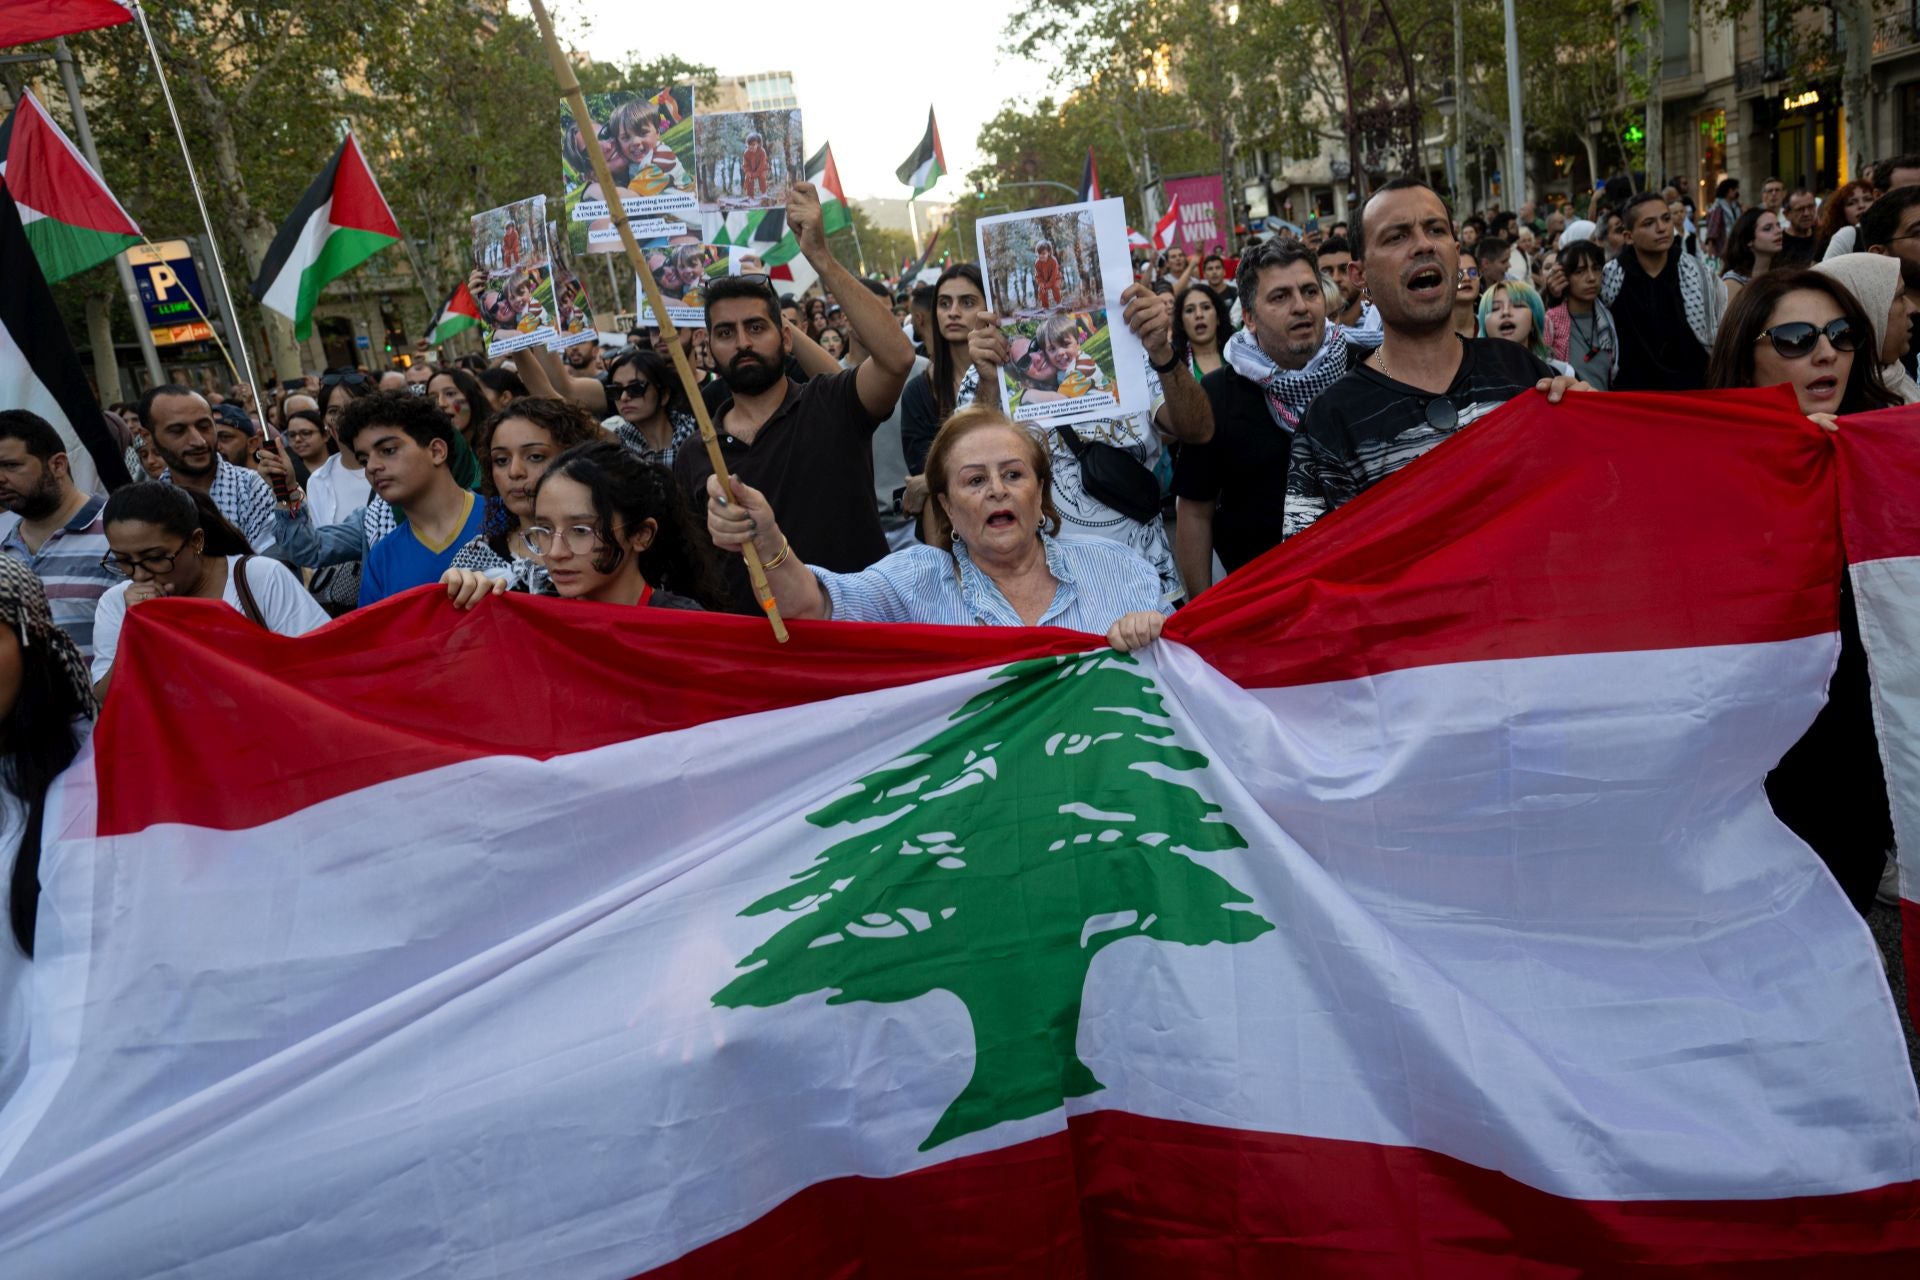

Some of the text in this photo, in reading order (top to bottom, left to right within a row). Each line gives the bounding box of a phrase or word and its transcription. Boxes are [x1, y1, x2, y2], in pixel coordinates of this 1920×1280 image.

[1180, 201, 1214, 223] WIN
[1182, 221, 1217, 243] WIN
[149, 266, 177, 301] P
